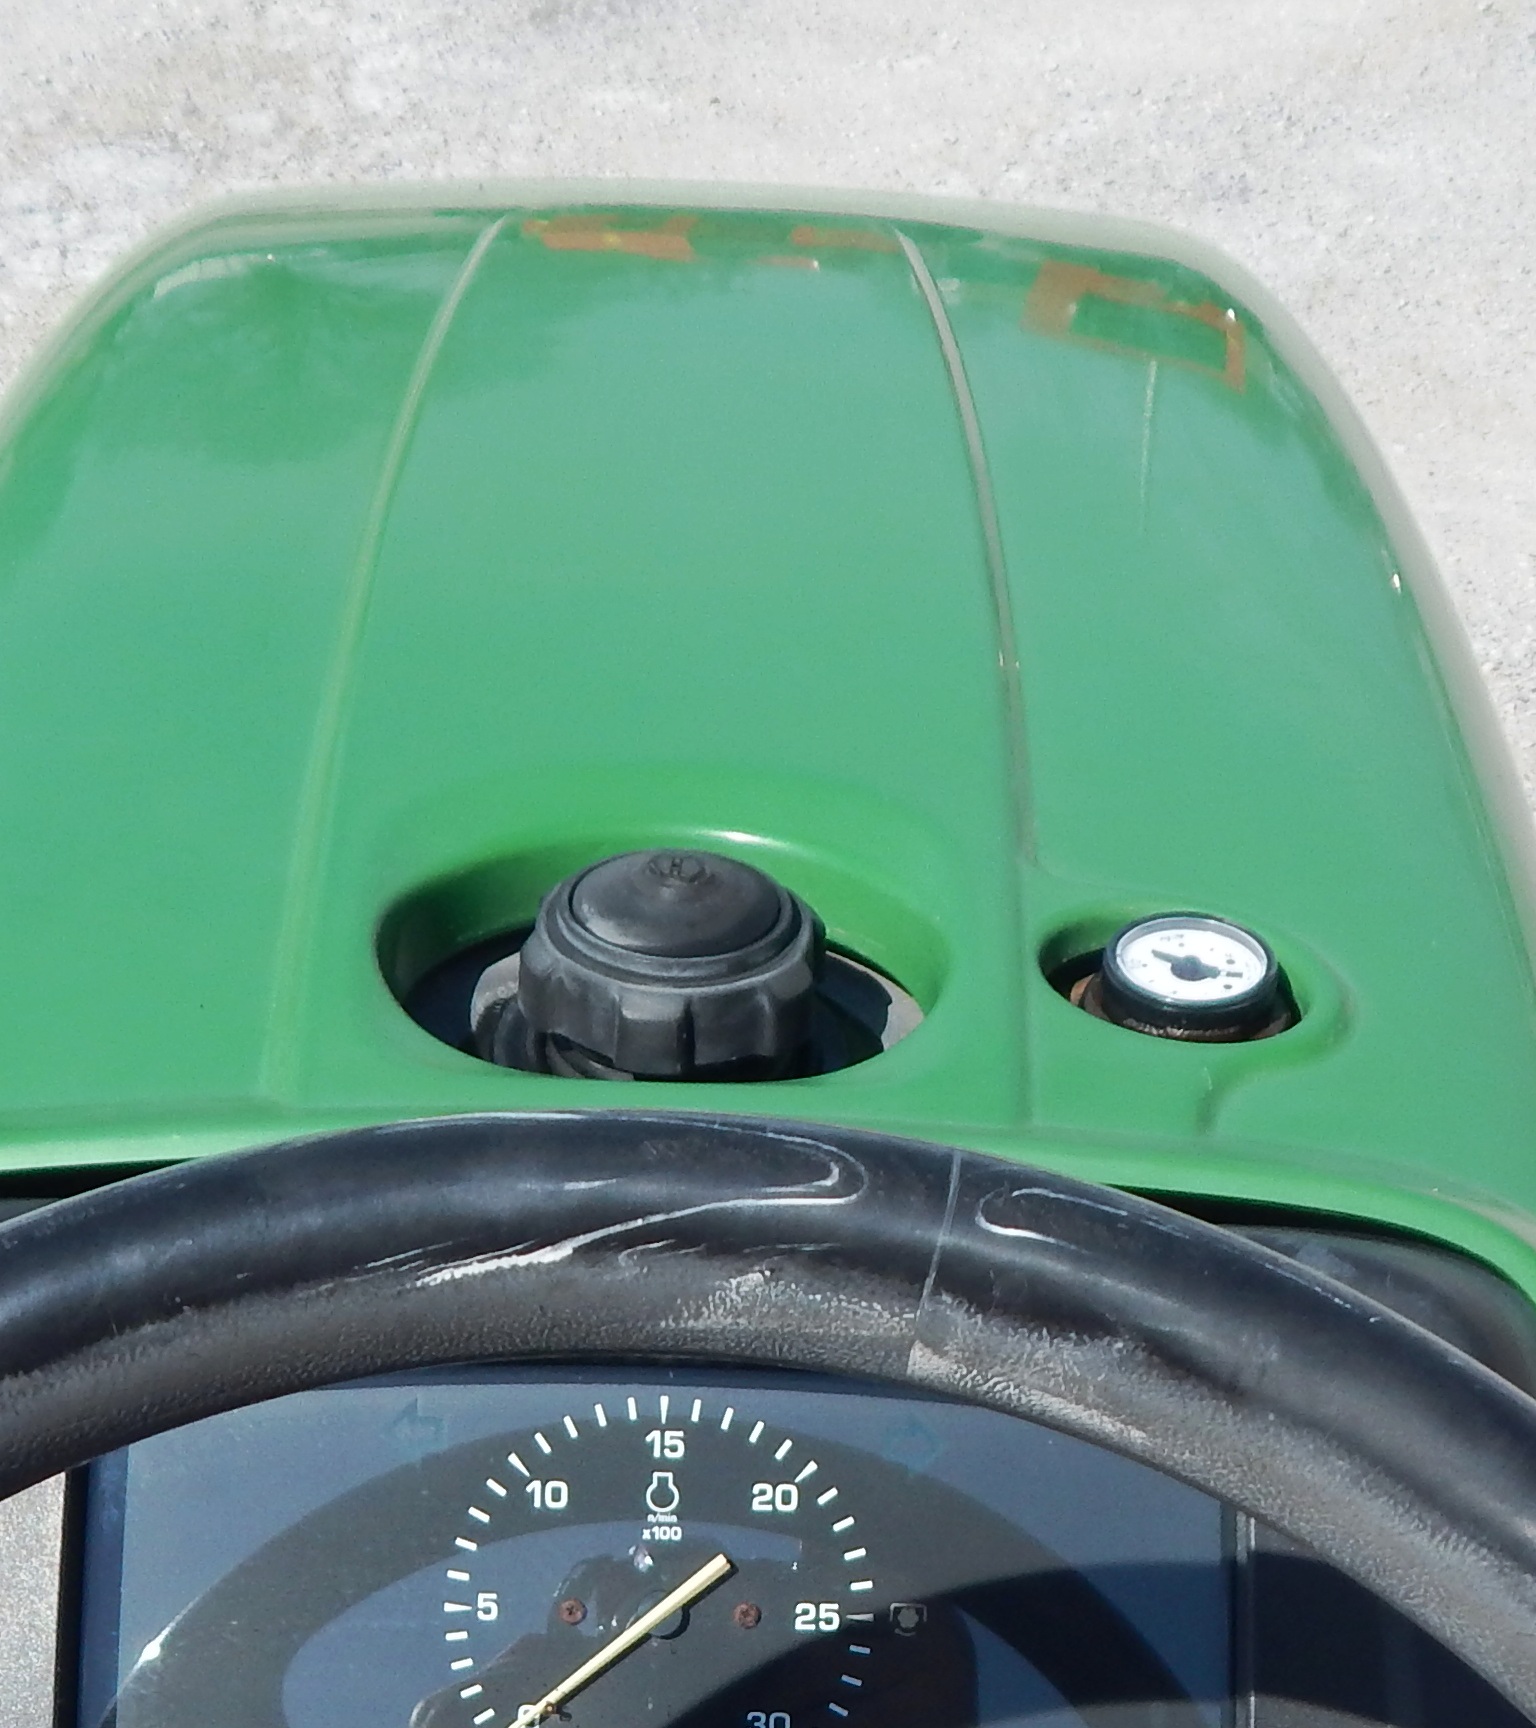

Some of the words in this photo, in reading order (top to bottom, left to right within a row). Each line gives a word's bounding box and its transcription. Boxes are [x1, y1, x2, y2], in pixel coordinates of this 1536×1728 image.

[645, 1429, 685, 1460] 15
[525, 1479, 569, 1510] 10
[751, 1483, 799, 1513] 20
[642, 1526, 682, 1541] x100
[476, 1592, 499, 1623] 5
[794, 1602, 840, 1632] 25
